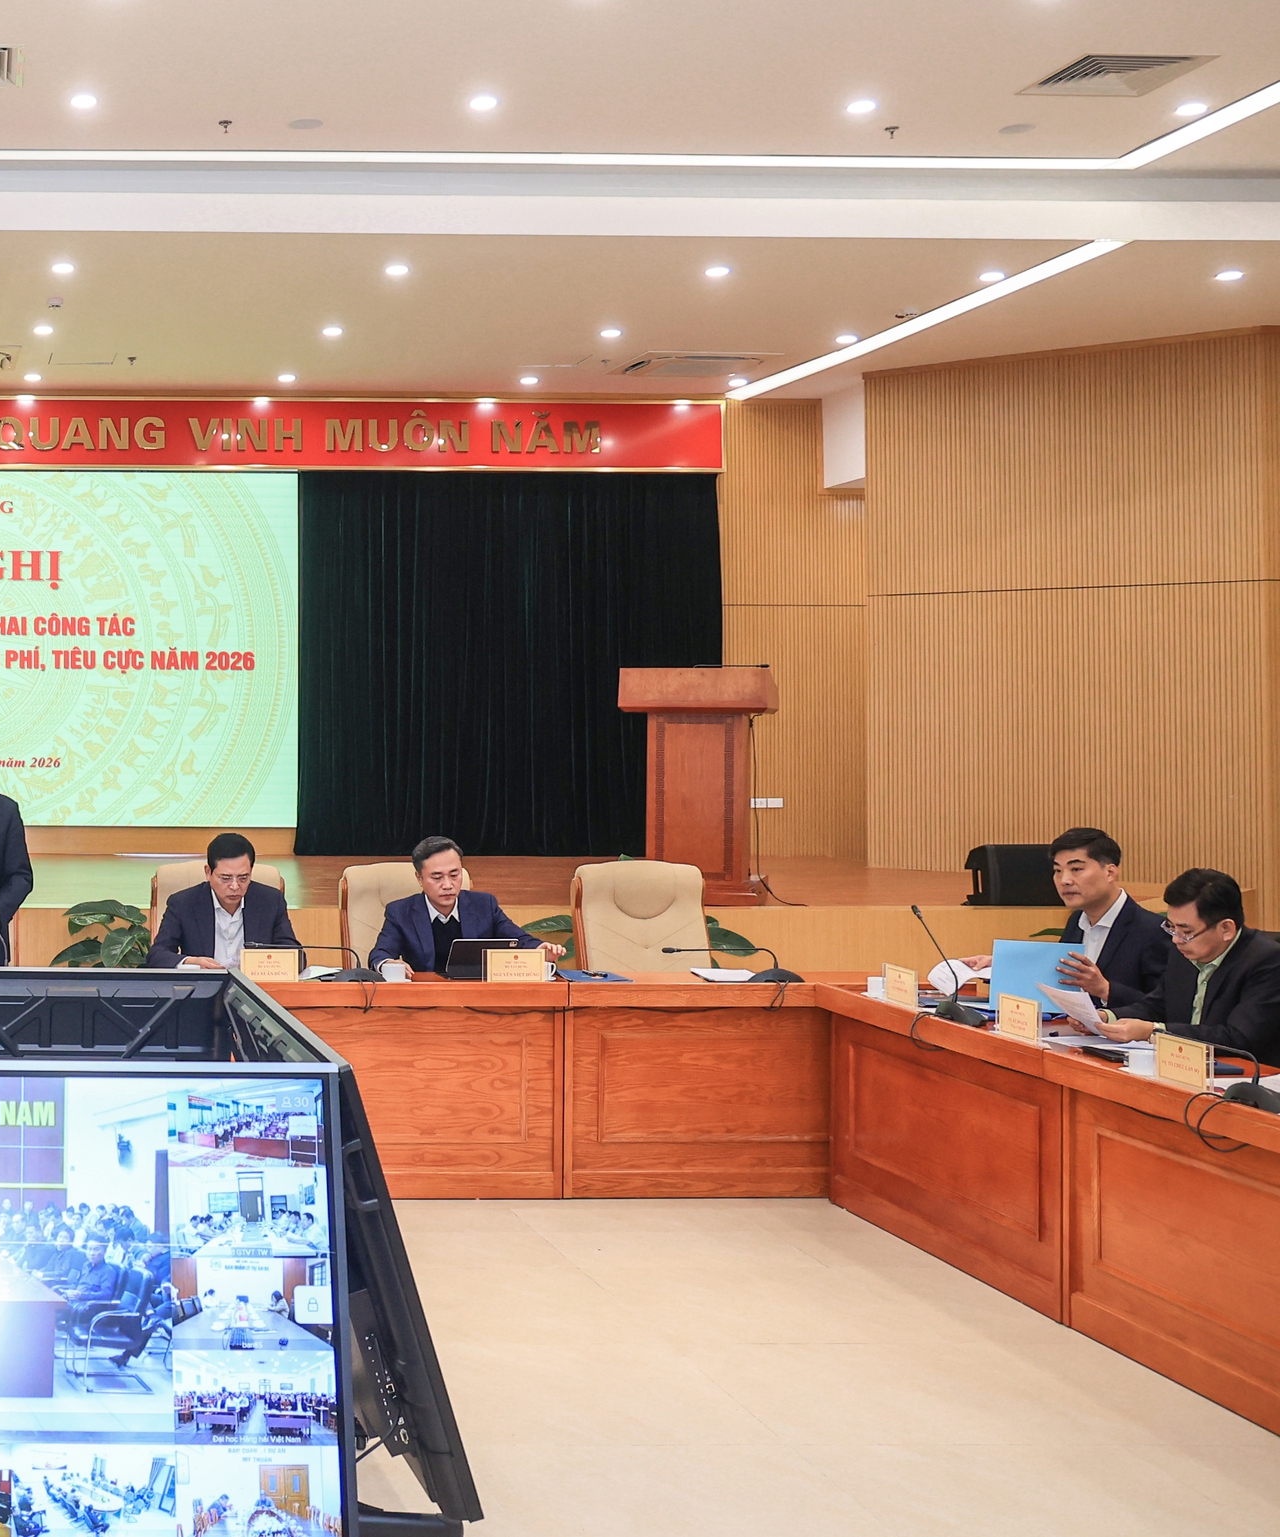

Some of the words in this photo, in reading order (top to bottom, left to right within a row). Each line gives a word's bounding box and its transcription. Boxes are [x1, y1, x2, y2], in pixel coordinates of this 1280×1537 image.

[188, 417, 303, 451] VINH
[325, 409, 470, 453] MUÔN
[491, 409, 602, 454] NĂM
[33, 613, 91, 636] CÔNG
[96, 613, 135, 636] TÁC
[5, 646, 46, 671] PHÍ,
[51, 646, 97, 670] TIÊU
[103, 648, 145, 674] CỰC
[150, 647, 199, 671] NĂM
[205, 651, 255, 671] 2026
[30, 757, 61, 768] 2026
[294, 1097, 309, 1107] 30
